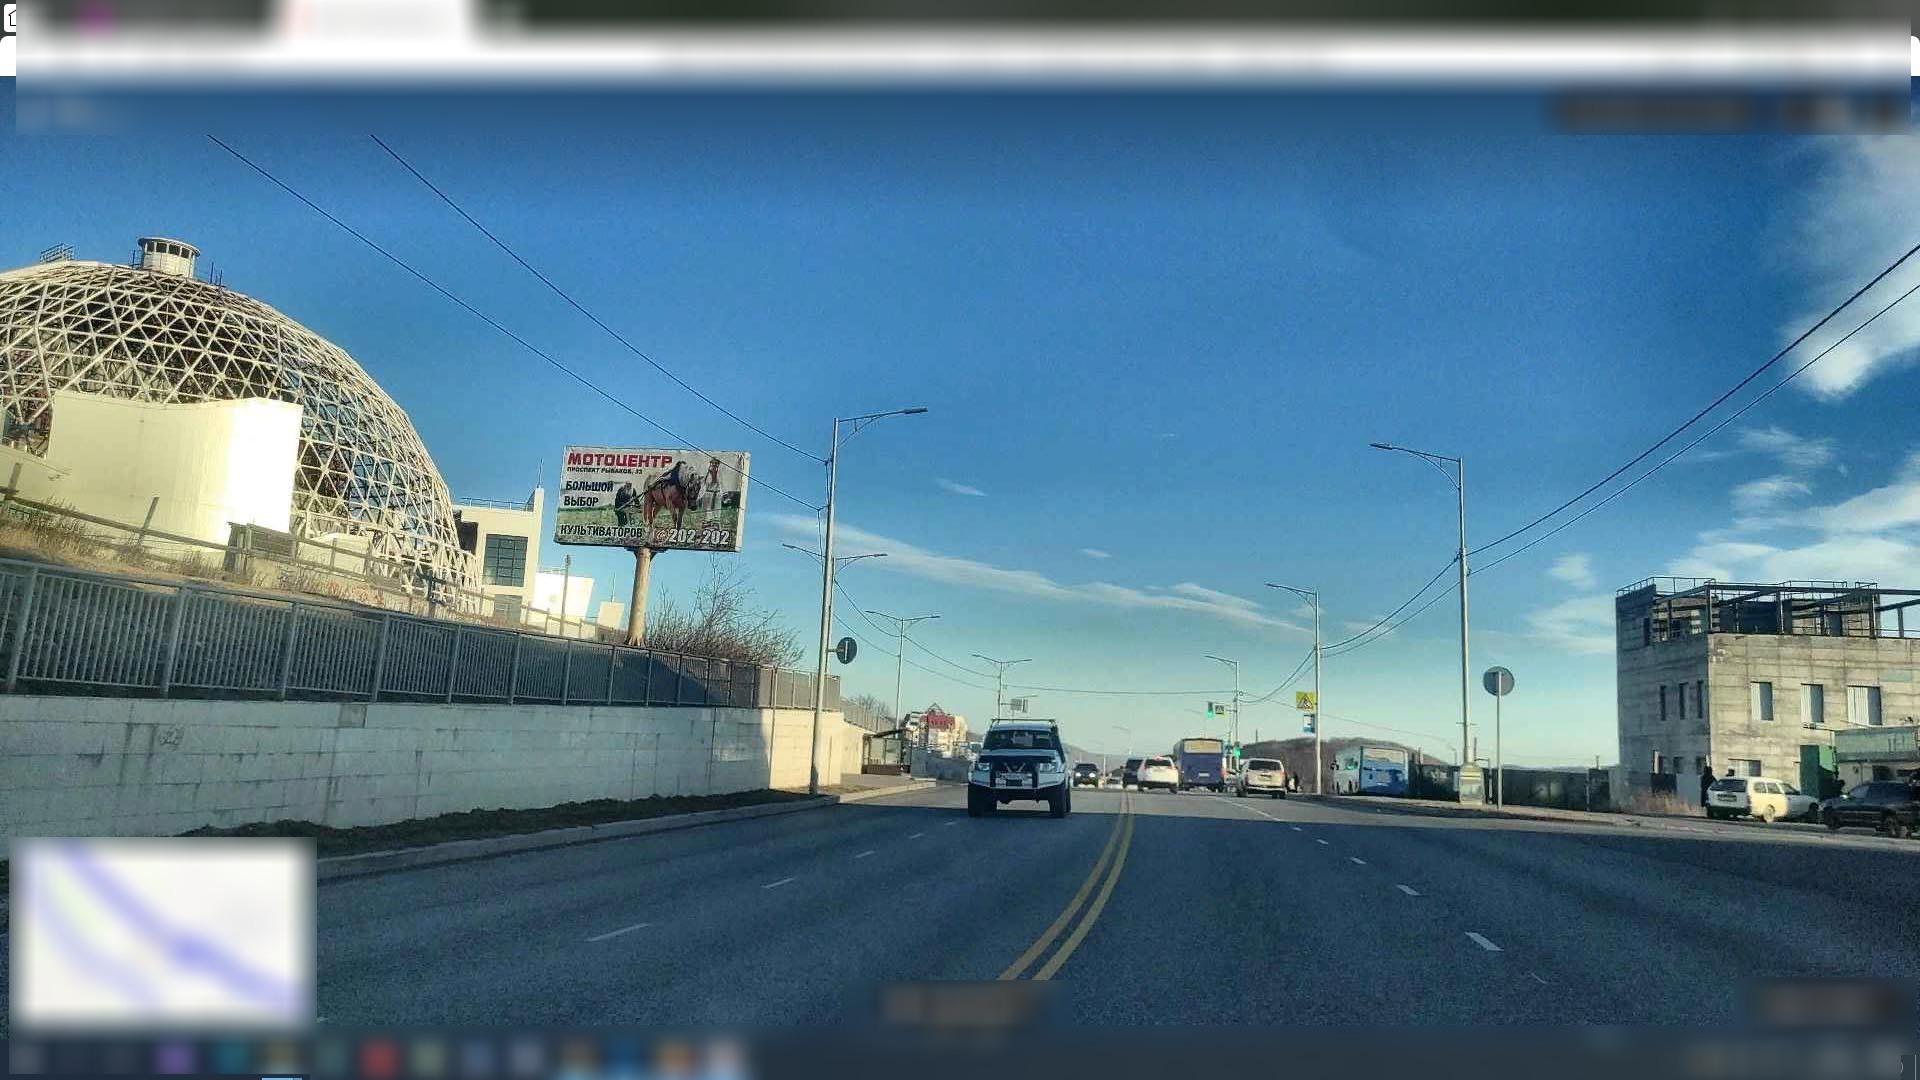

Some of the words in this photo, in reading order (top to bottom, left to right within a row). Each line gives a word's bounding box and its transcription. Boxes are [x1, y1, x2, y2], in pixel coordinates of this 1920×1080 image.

[567, 452, 673, 468] МОТОЦЕНТР
[565, 480, 614, 492] БОЛЬШОЙ
[563, 495, 599, 507] ВЫБОР
[560, 524, 643, 538] КУЛЬТИВАТОРОВ
